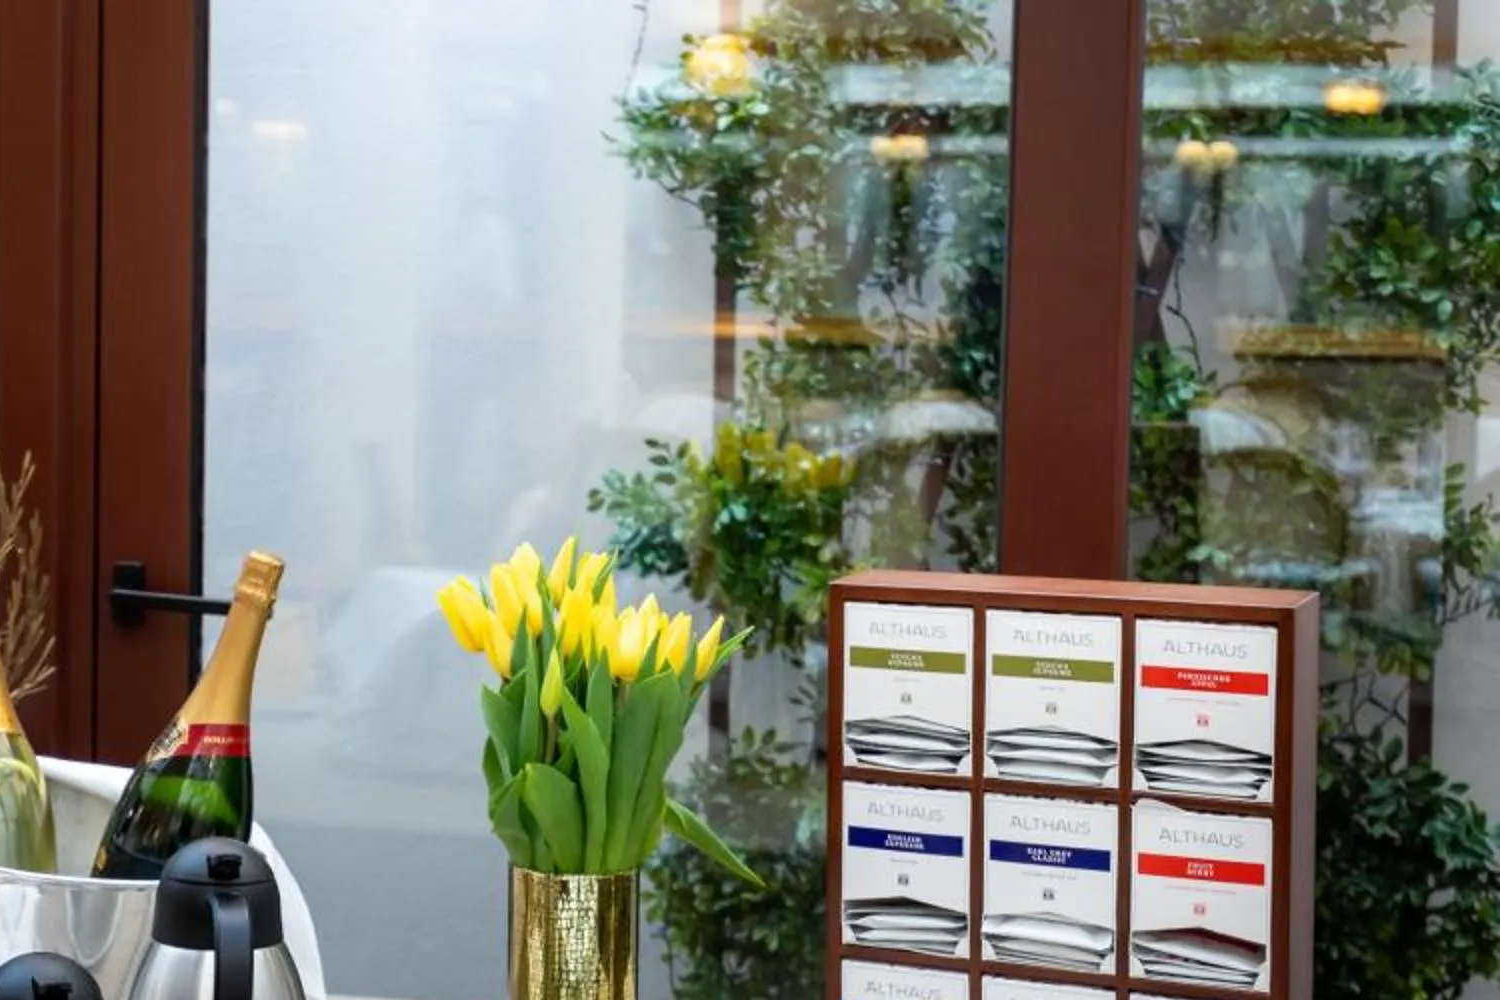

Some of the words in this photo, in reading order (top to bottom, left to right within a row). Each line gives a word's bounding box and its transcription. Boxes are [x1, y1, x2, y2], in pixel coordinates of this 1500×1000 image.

[868, 621, 948, 639] ALTHAUS
[1012, 629, 1094, 647] ALTHAUS
[1163, 639, 1248, 659] ALTHAUS
[867, 802, 946, 822] ALTHAUS
[1010, 815, 1091, 836] ALTHAUS
[1159, 827, 1244, 848] ALTHAUS
